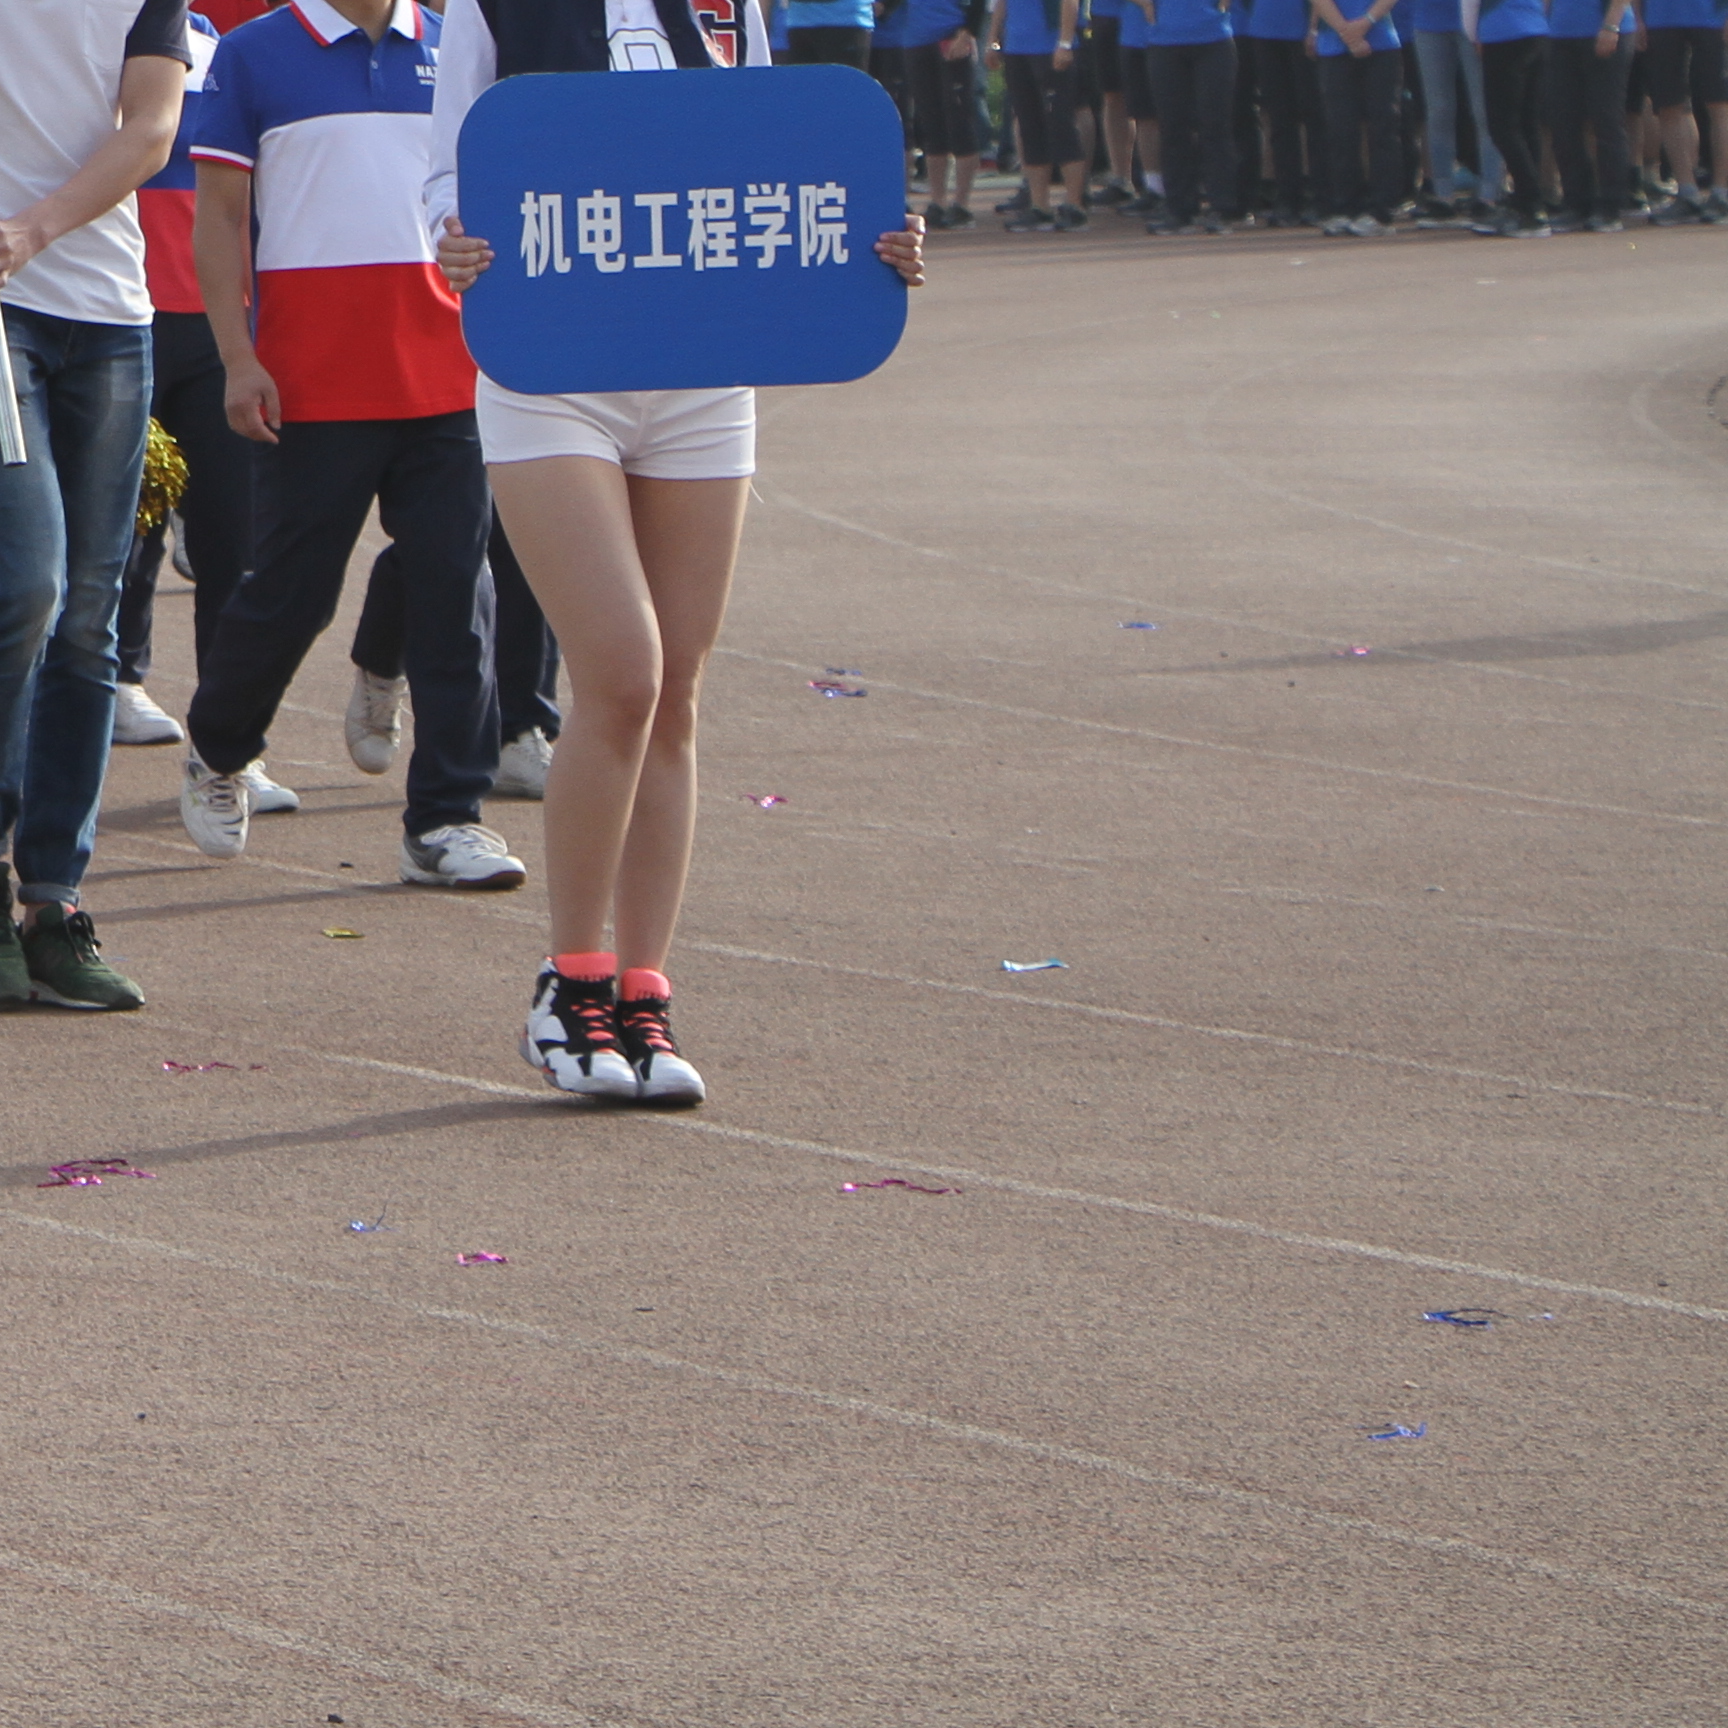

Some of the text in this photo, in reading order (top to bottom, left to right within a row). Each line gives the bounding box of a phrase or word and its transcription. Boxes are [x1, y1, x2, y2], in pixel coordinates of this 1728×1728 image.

[520, 182, 849, 278] 机电工程学院
